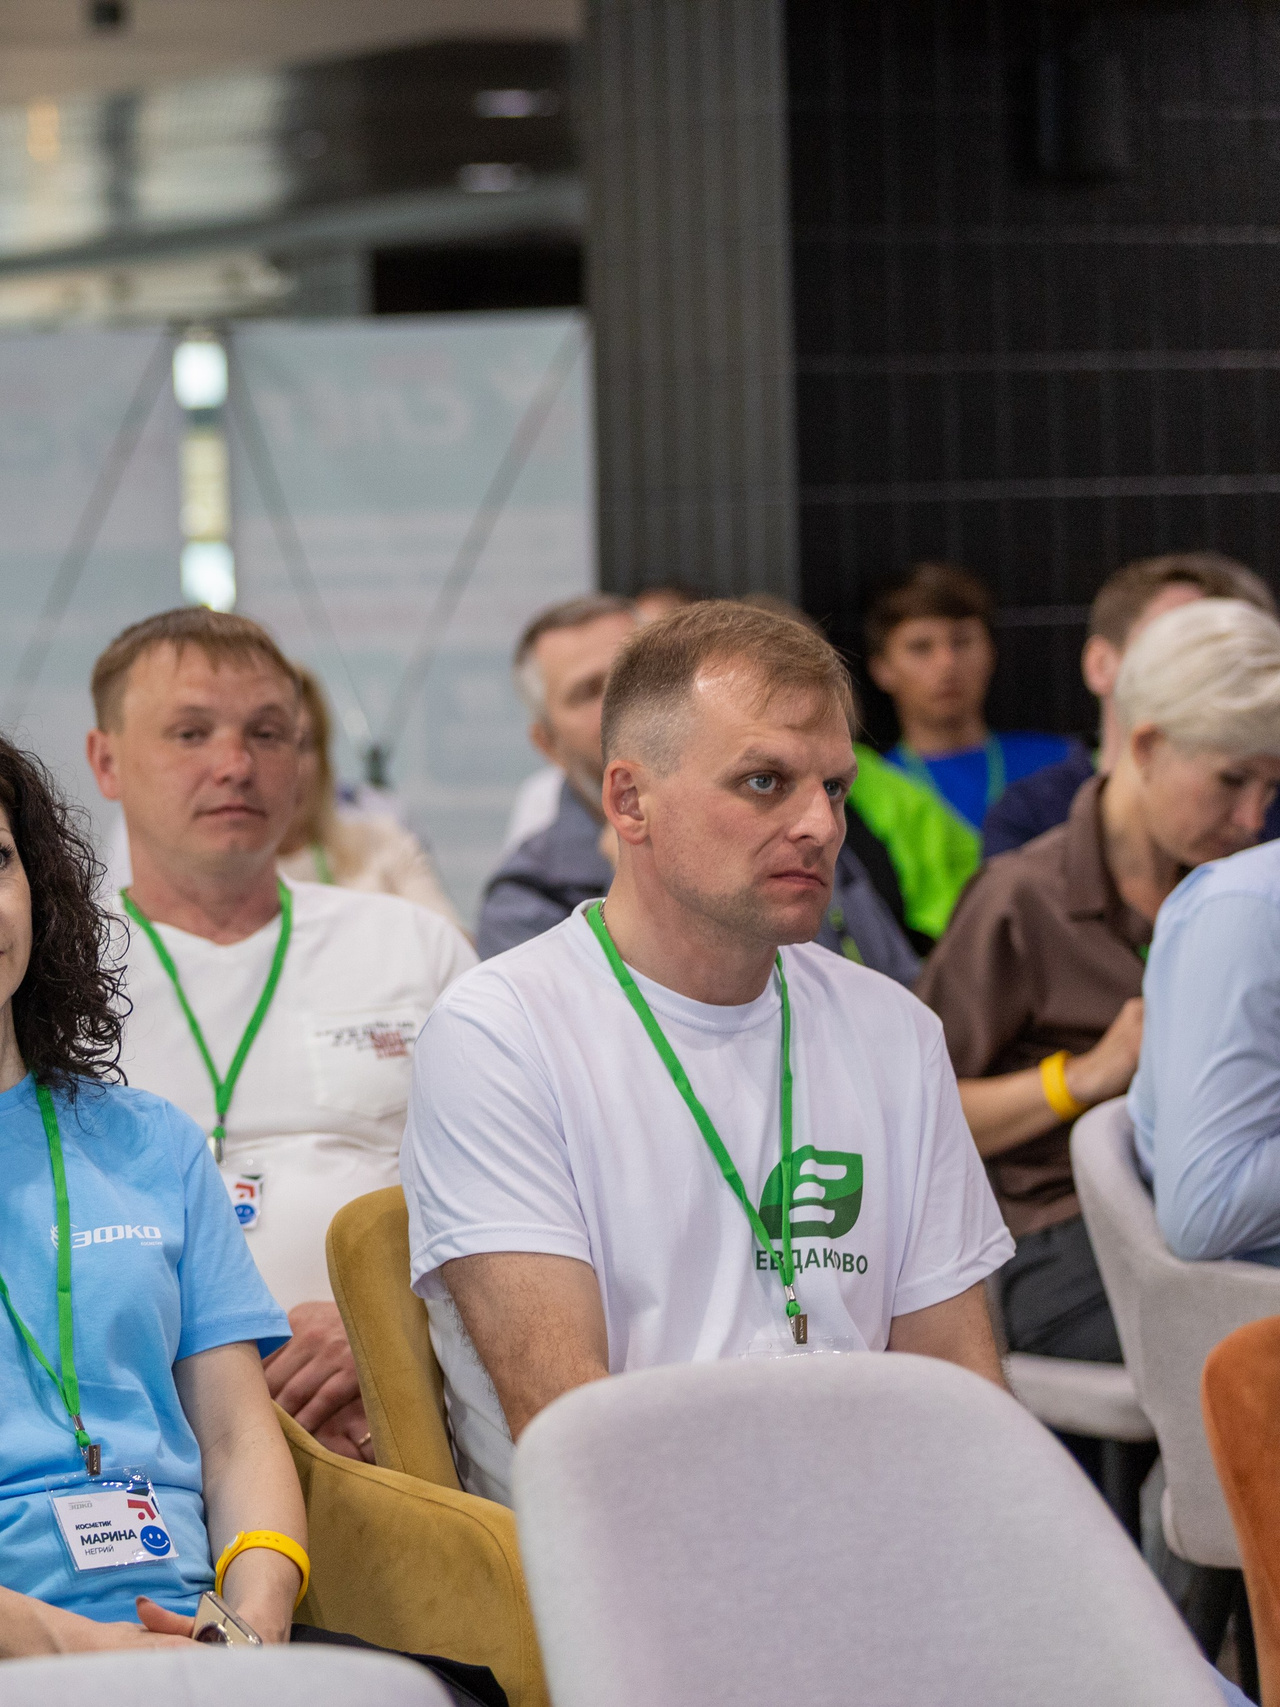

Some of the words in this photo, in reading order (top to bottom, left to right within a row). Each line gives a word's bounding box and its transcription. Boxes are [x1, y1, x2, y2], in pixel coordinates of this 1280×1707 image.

[72, 1224, 162, 1249] ЭФКО
[75, 1520, 112, 1531] КОСМЕТИК
[80, 1529, 138, 1546] МАРИНА
[85, 1545, 115, 1556] НЕГРИЙ
